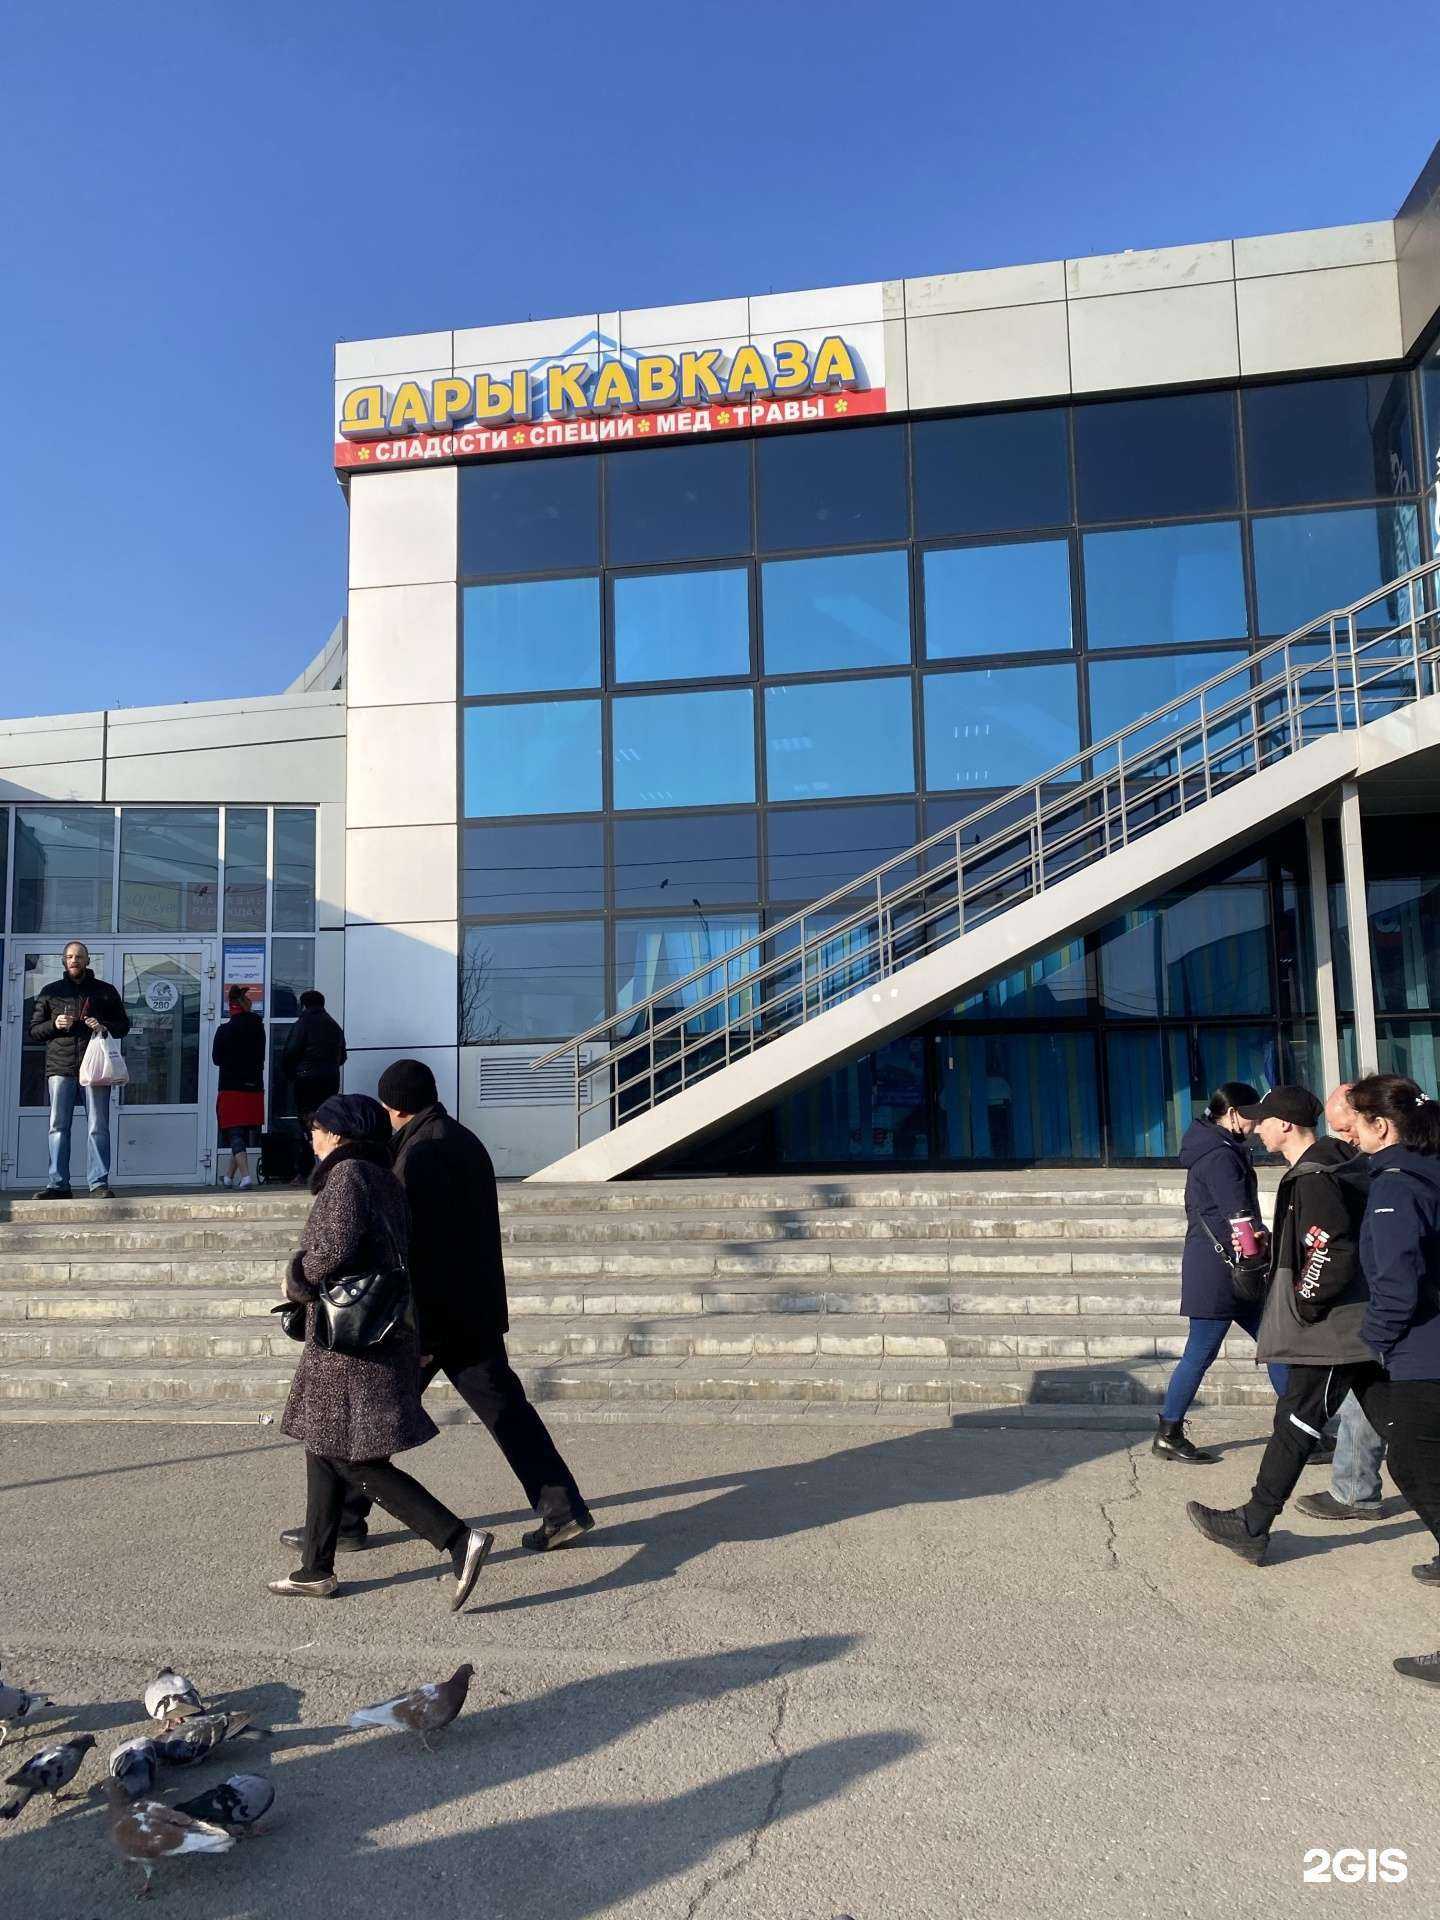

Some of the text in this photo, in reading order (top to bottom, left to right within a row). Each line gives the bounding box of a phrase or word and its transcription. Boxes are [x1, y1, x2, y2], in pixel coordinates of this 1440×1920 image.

[340, 336, 857, 438] ДАРЫ КАВКАЗА
[375, 398, 825, 461] СЛАДОСТИ СПЕЦИИ МЕД ТРАВЫ
